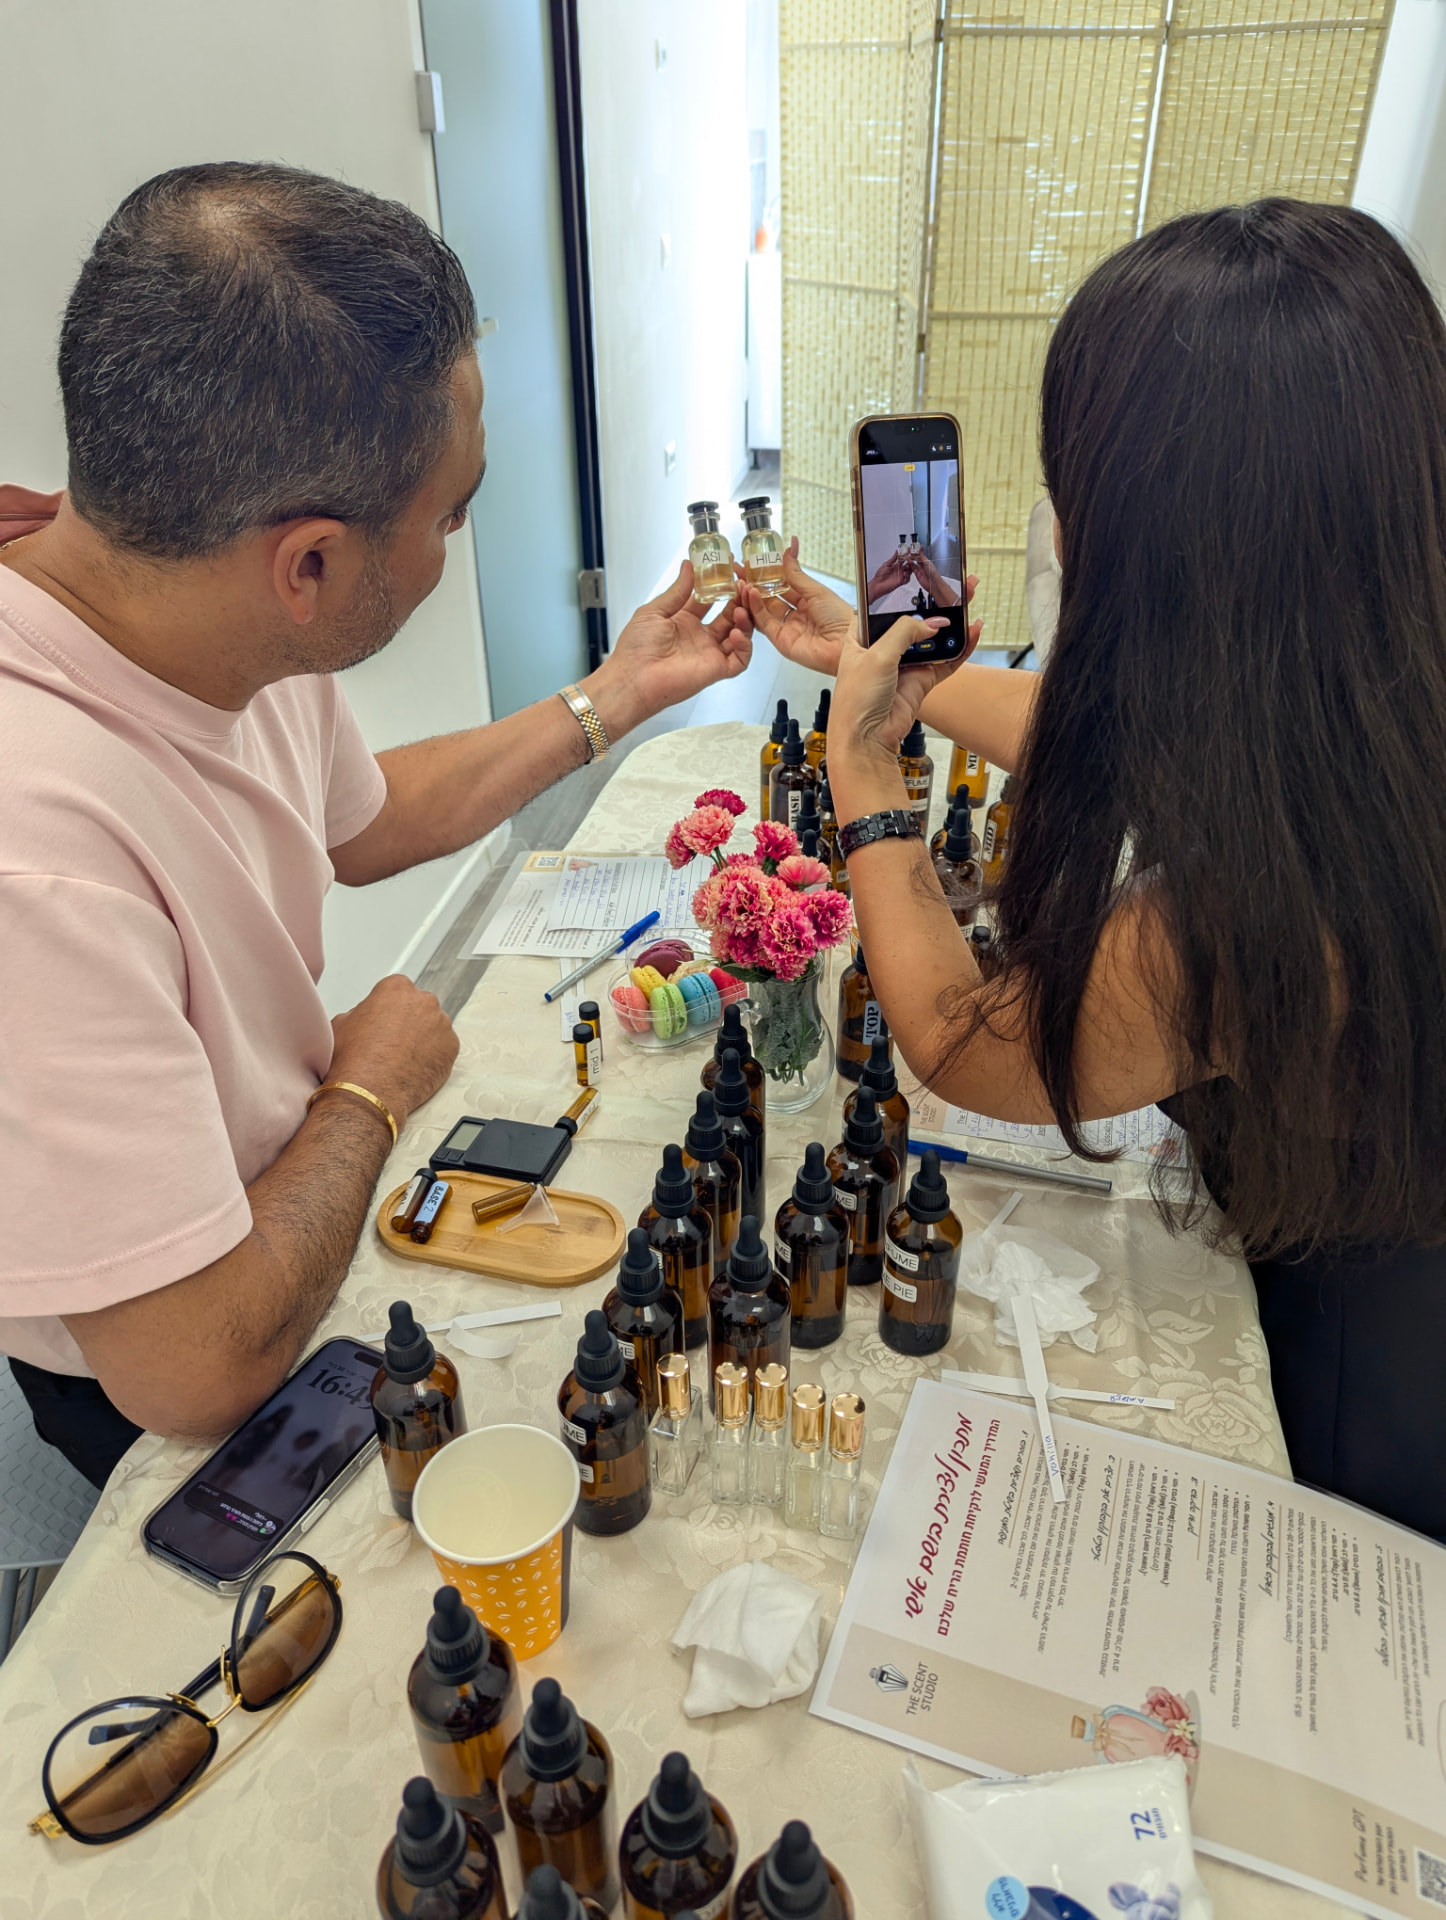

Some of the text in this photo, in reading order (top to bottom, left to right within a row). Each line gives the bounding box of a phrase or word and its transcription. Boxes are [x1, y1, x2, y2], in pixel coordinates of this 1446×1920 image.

[702, 551, 721, 564] ASI
[756, 553, 783, 565] HILA
[904, 778, 929, 788] RFUME
[790, 795, 800, 825] BASE
[984, 826, 995, 857] MID
[866, 1006, 879, 1038] TOP
[591, 1055, 600, 1074] mid
[427, 1185, 443, 1206] BASE
[893, 1284, 914, 1299] PIE
[1109, 1455, 1115, 1463] 2.
[905, 1412, 971, 1617] מתכון ליצירת בושם אישי
[937, 1420, 1000, 1636] המדריך המעשי לרקיחת חותמת הריח שלכם
[906, 1662, 928, 1714] THE SCENT
[921, 1673, 938, 1711] STUDIO
[1130, 1810, 1155, 1840] 72
[992, 1894, 1004, 1912] ללא
